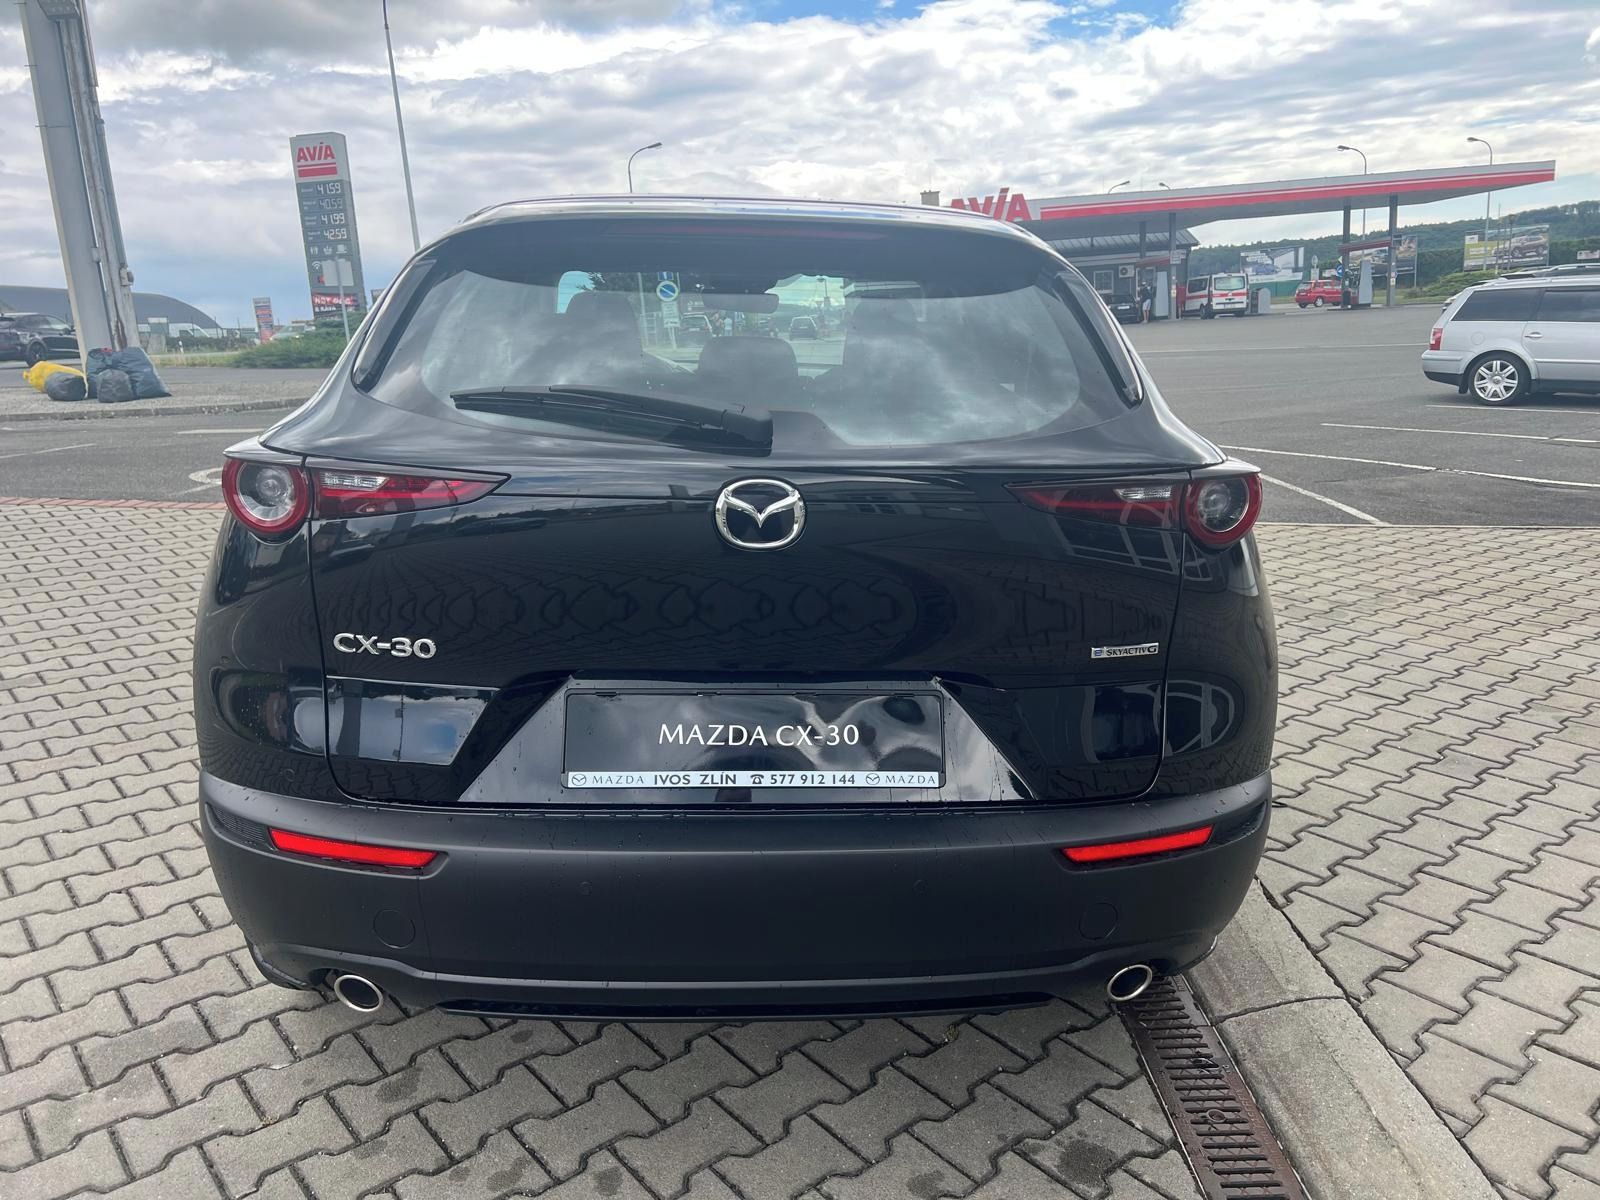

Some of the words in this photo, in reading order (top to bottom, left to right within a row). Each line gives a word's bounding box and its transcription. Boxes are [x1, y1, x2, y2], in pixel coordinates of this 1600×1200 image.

[333, 632, 437, 659] CX-30
[658, 723, 768, 746] MAZDA
[775, 724, 860, 746] CX-30
[592, 775, 645, 785] MAZDA
[654, 774, 691, 785] IVOS
[700, 771, 737, 785] ZLÍN
[770, 774, 796, 785] 577
[801, 774, 826, 785] 912
[832, 774, 856, 785] 144
[885, 774, 936, 785] MAZDA
